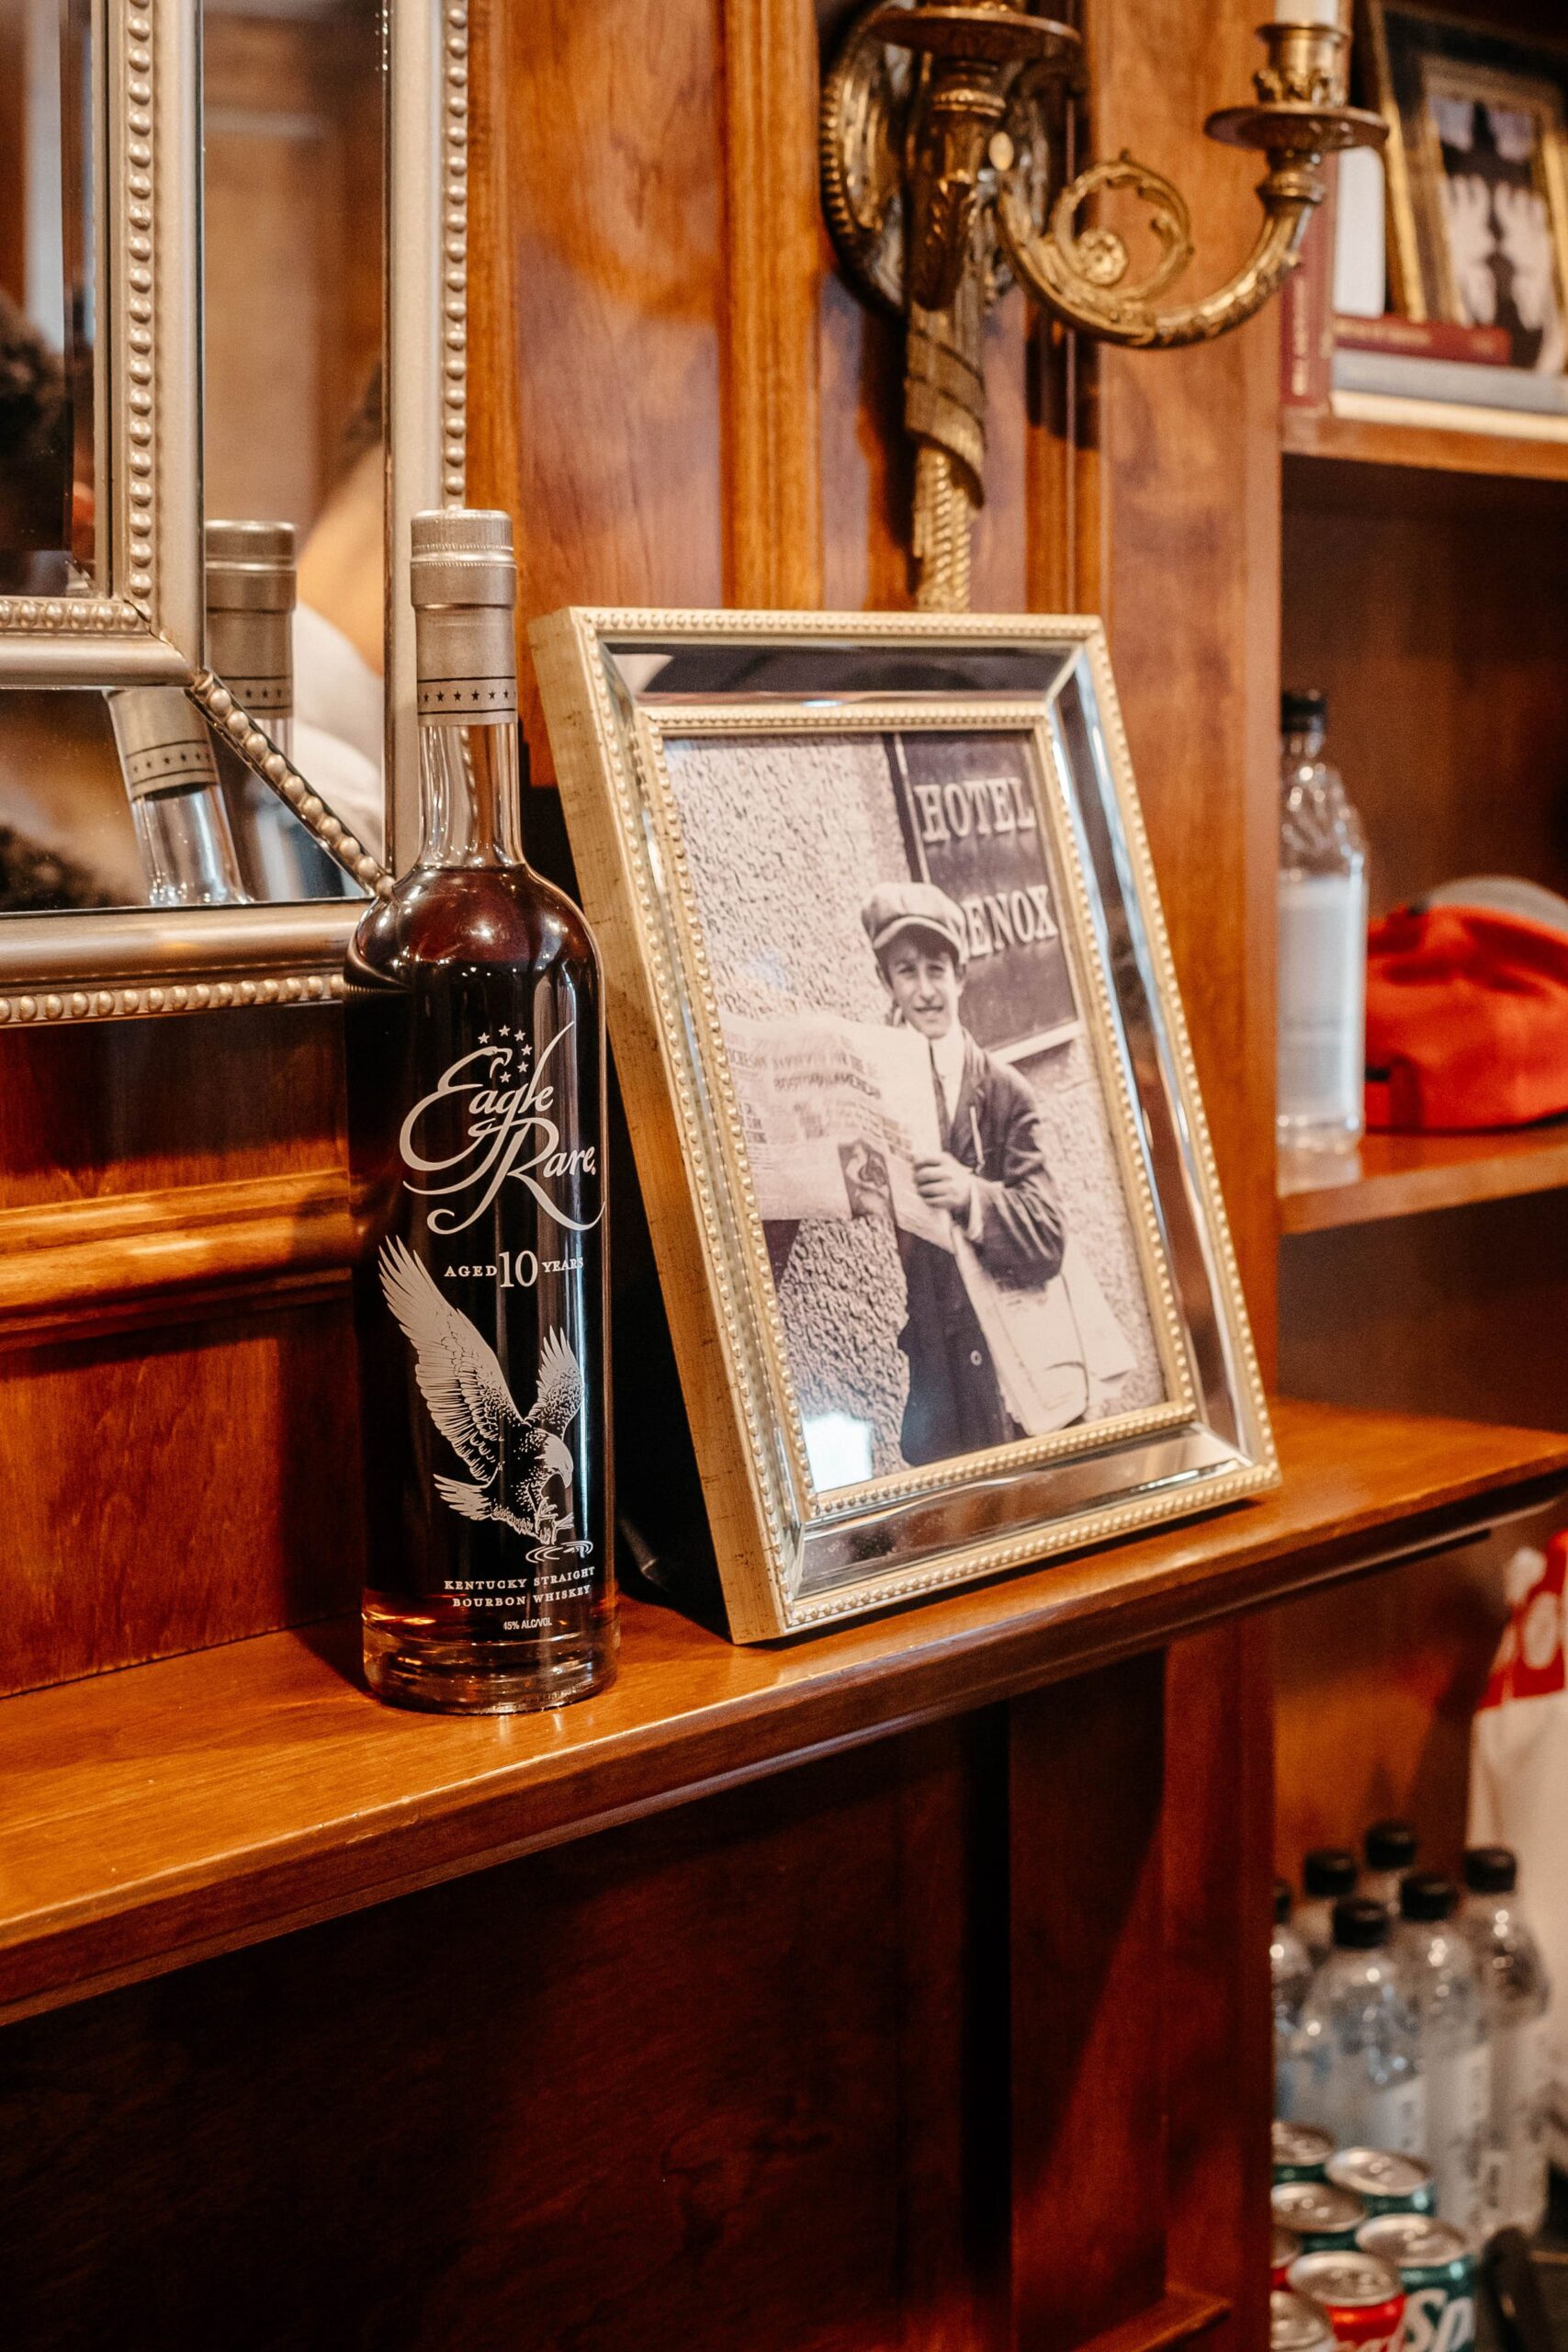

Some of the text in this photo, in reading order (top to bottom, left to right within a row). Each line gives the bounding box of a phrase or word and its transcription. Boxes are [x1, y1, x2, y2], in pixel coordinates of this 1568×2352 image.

[913, 777, 1037, 842] HOTEL
[959, 884, 1057, 957] ENOX
[400, 1021, 575, 1195] Eagle
[445, 1250, 583, 1287] AGED 10 YEARS
[445, 1566, 595, 1590] KENTUCKY STRAIGHT
[453, 1585, 591, 1607] BOURBON WHISKEY
